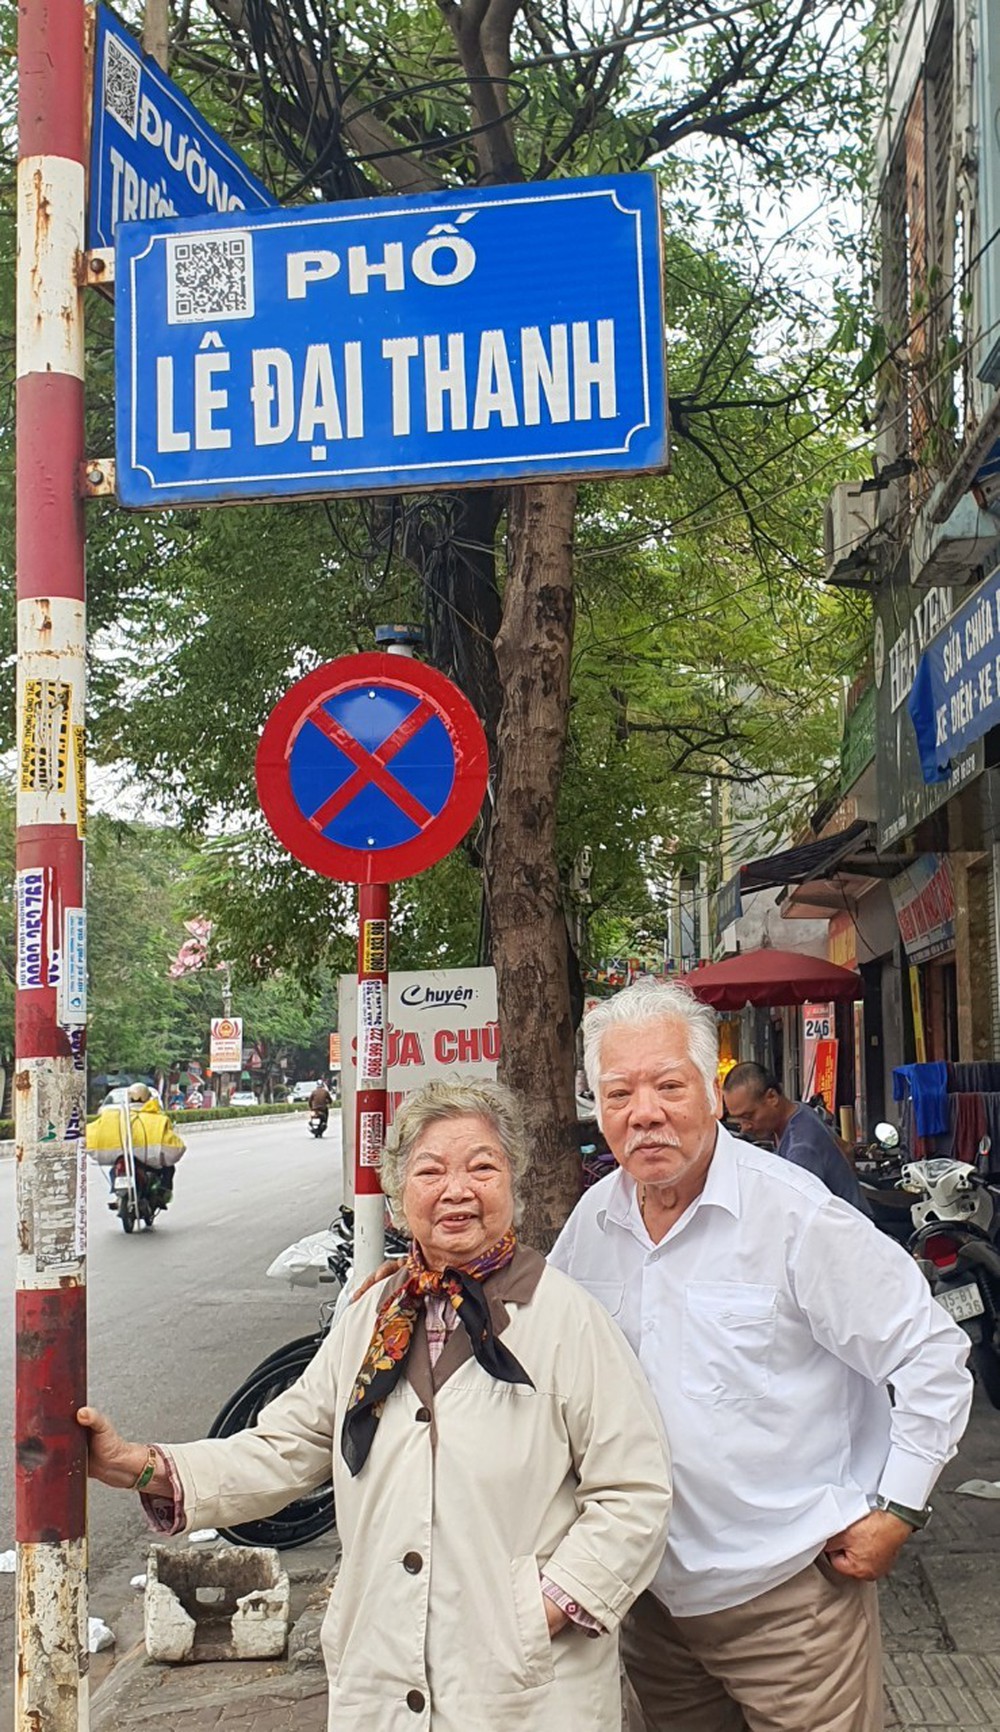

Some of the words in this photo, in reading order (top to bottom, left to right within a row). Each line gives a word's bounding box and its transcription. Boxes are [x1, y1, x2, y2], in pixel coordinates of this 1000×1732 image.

[286, 212, 476, 299] PHỐ
[156, 331, 231, 454] LÊ
[250, 342, 363, 461] ĐẠI
[381, 319, 617, 437] THANH
[806, 1020, 830, 1037] 246
